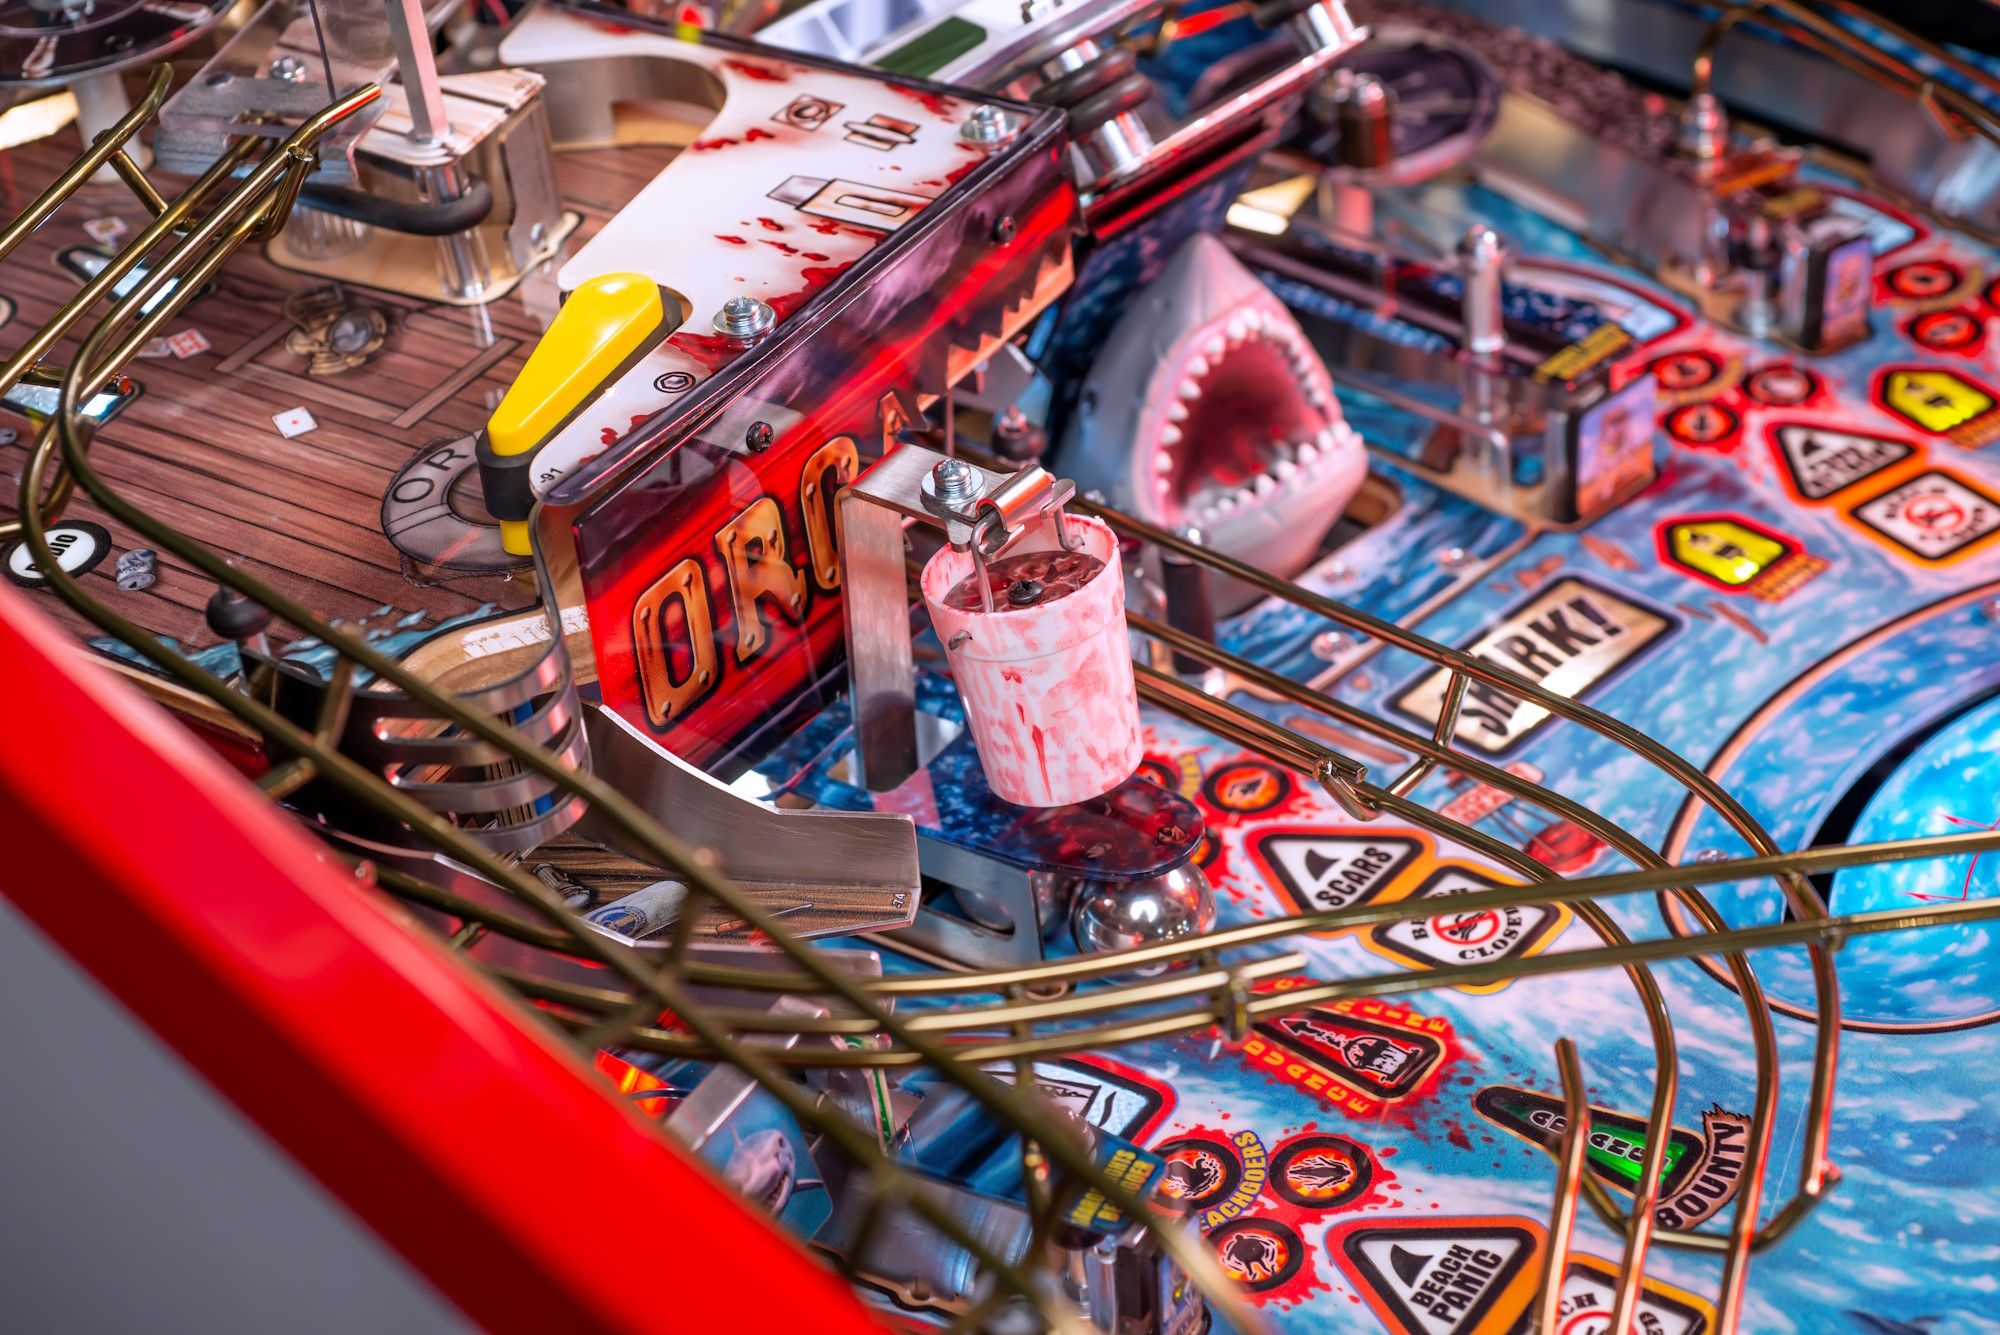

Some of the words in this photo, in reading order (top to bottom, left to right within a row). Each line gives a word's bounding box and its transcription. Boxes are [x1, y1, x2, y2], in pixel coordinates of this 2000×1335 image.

[1315, 847, 1392, 906] SCARS
[1655, 1121, 1746, 1228] BOUNTY
[1410, 1244, 1473, 1309] BEACH
[1427, 1249, 1503, 1325] PANIC
